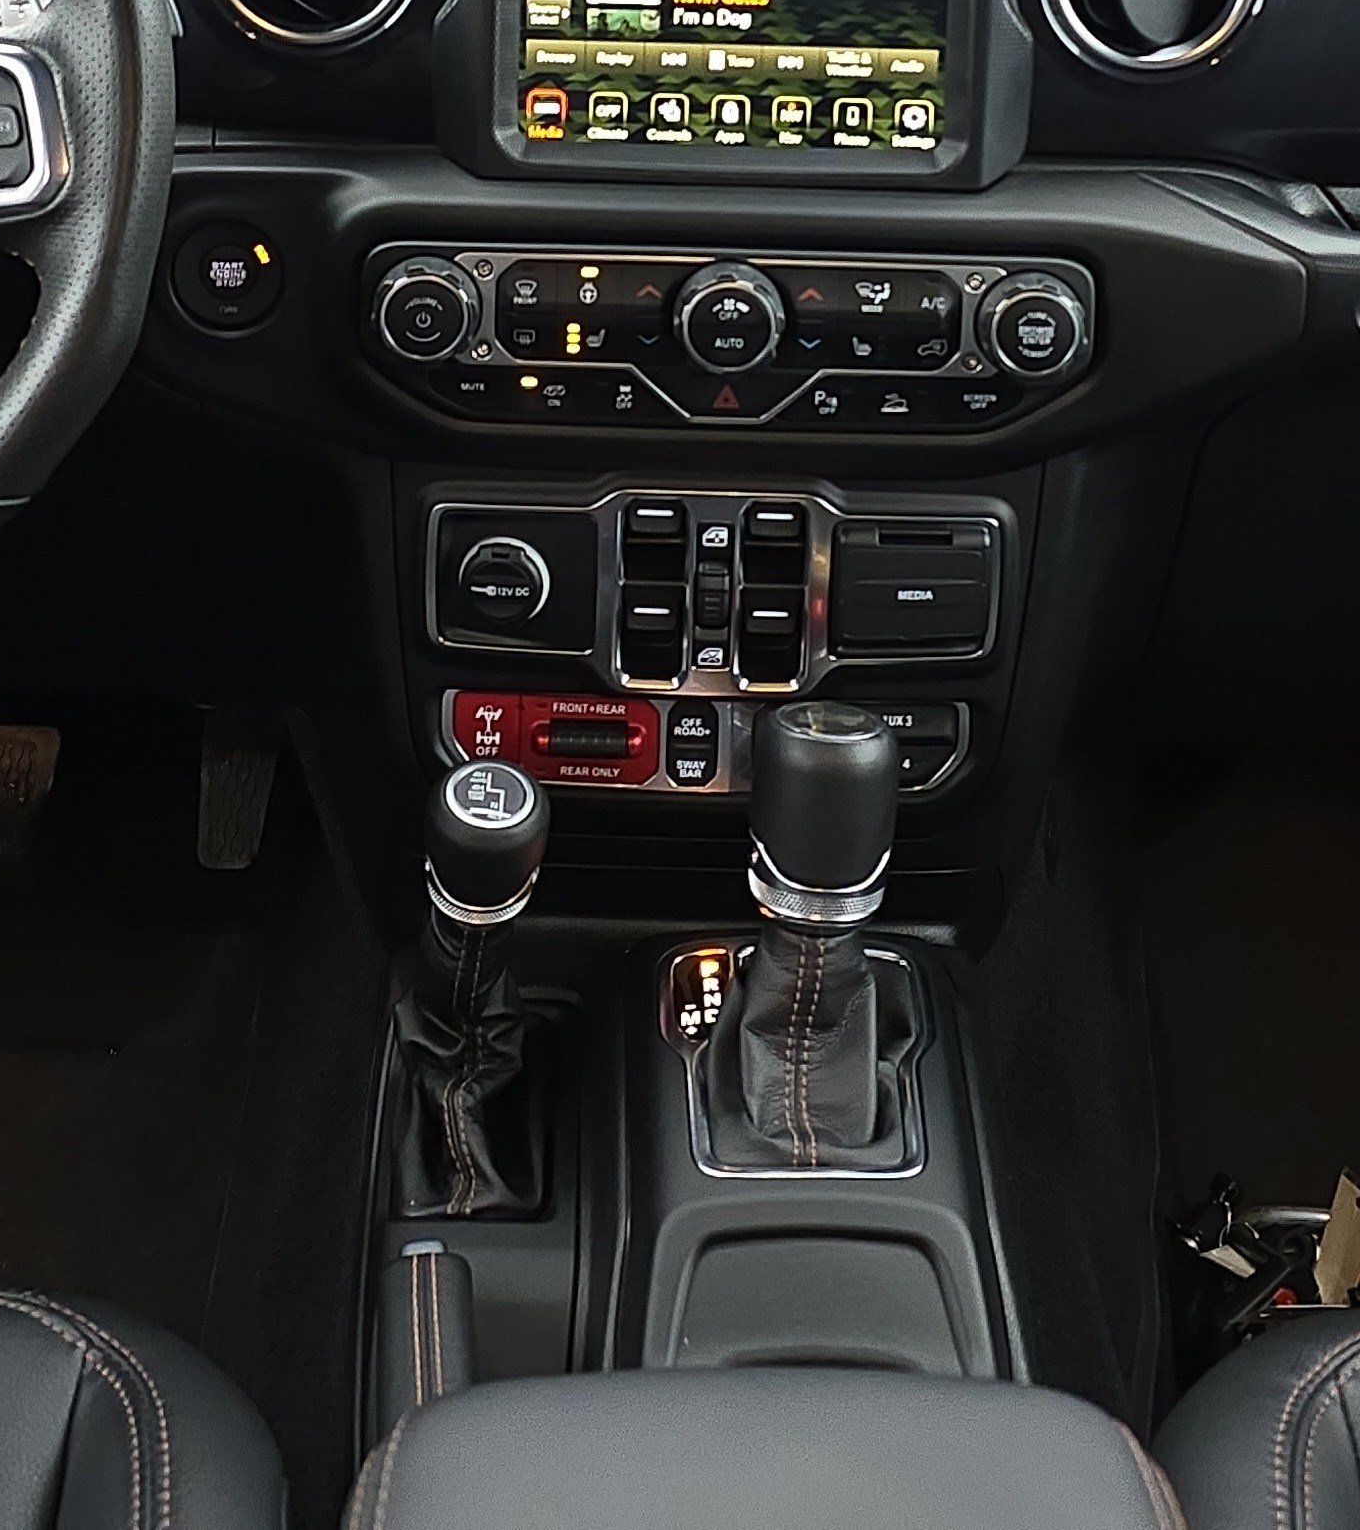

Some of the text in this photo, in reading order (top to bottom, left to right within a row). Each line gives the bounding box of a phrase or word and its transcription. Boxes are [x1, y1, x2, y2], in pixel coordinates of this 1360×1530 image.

[701, 11, 715, 26] a
[716, 8, 752, 30] Dog
[921, 296, 946, 310] A/C
[714, 336, 745, 350] AUTO
[461, 382, 485, 391] MUTE
[897, 590, 934, 601] MEDIA
[681, 718, 702, 728] OFF
[882, 714, 914, 728] UX 3
[476, 746, 498, 756] OFF
[676, 759, 707, 770] SWAY
[560, 766, 621, 779] REAR ONLY
[679, 768, 703, 779] BAR
[702, 978, 719, 993] R
[703, 993, 722, 1008] N
[681, 1010, 701, 1027] M
